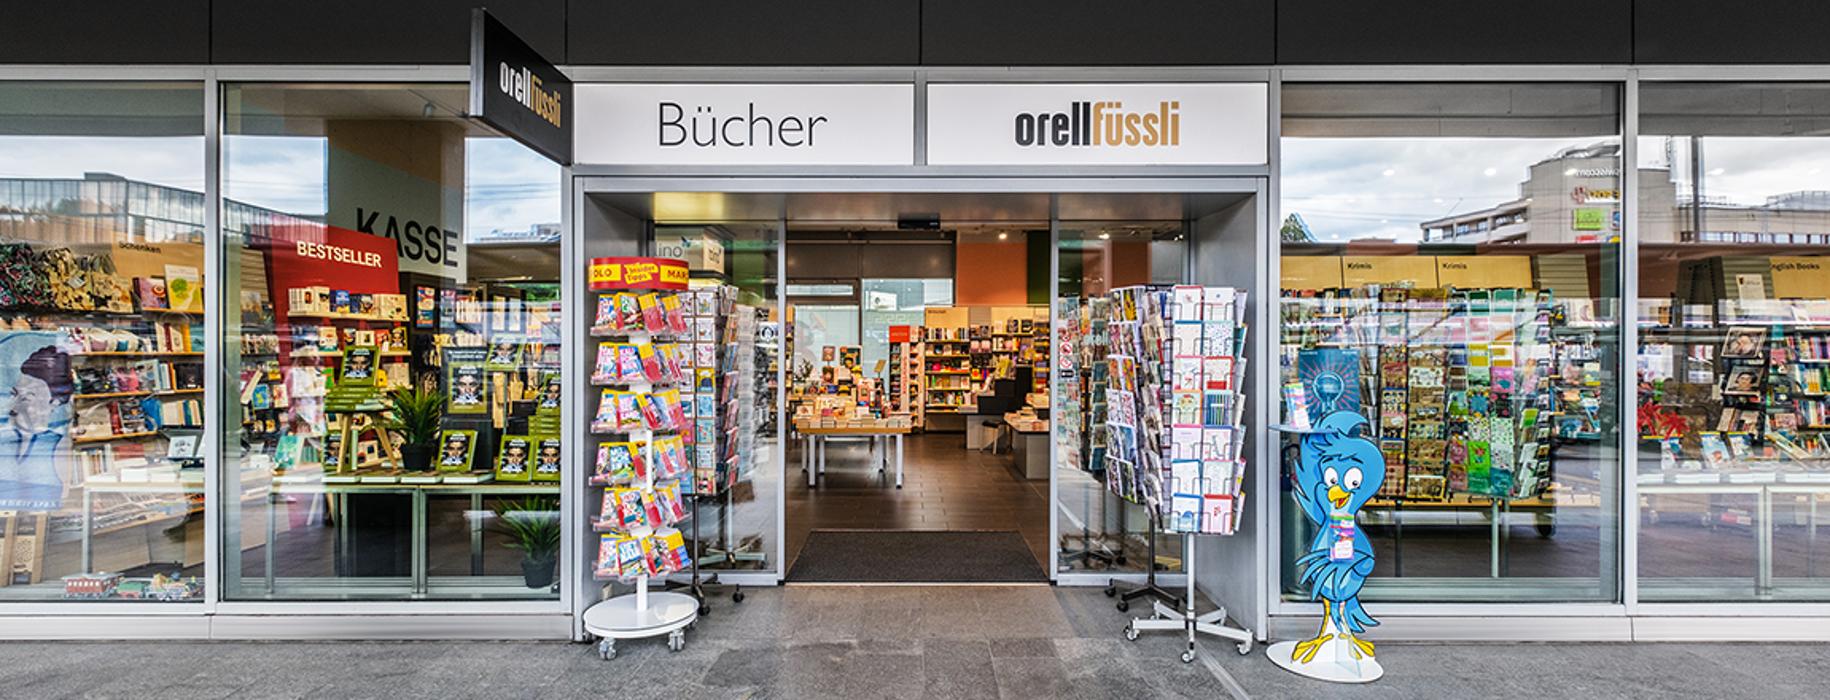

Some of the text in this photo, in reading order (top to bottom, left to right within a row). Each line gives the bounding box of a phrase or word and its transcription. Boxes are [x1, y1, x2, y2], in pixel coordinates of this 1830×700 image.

[500, 61, 560, 128] orellfüssli
[659, 102, 828, 147] Bücher
[1015, 101, 1180, 146] orellfüssli
[296, 240, 382, 268] BESTSELLER
[1347, 262, 1373, 270] Krimis
[1442, 262, 1468, 270] Krimis
[1771, 263, 1795, 272] nglish
